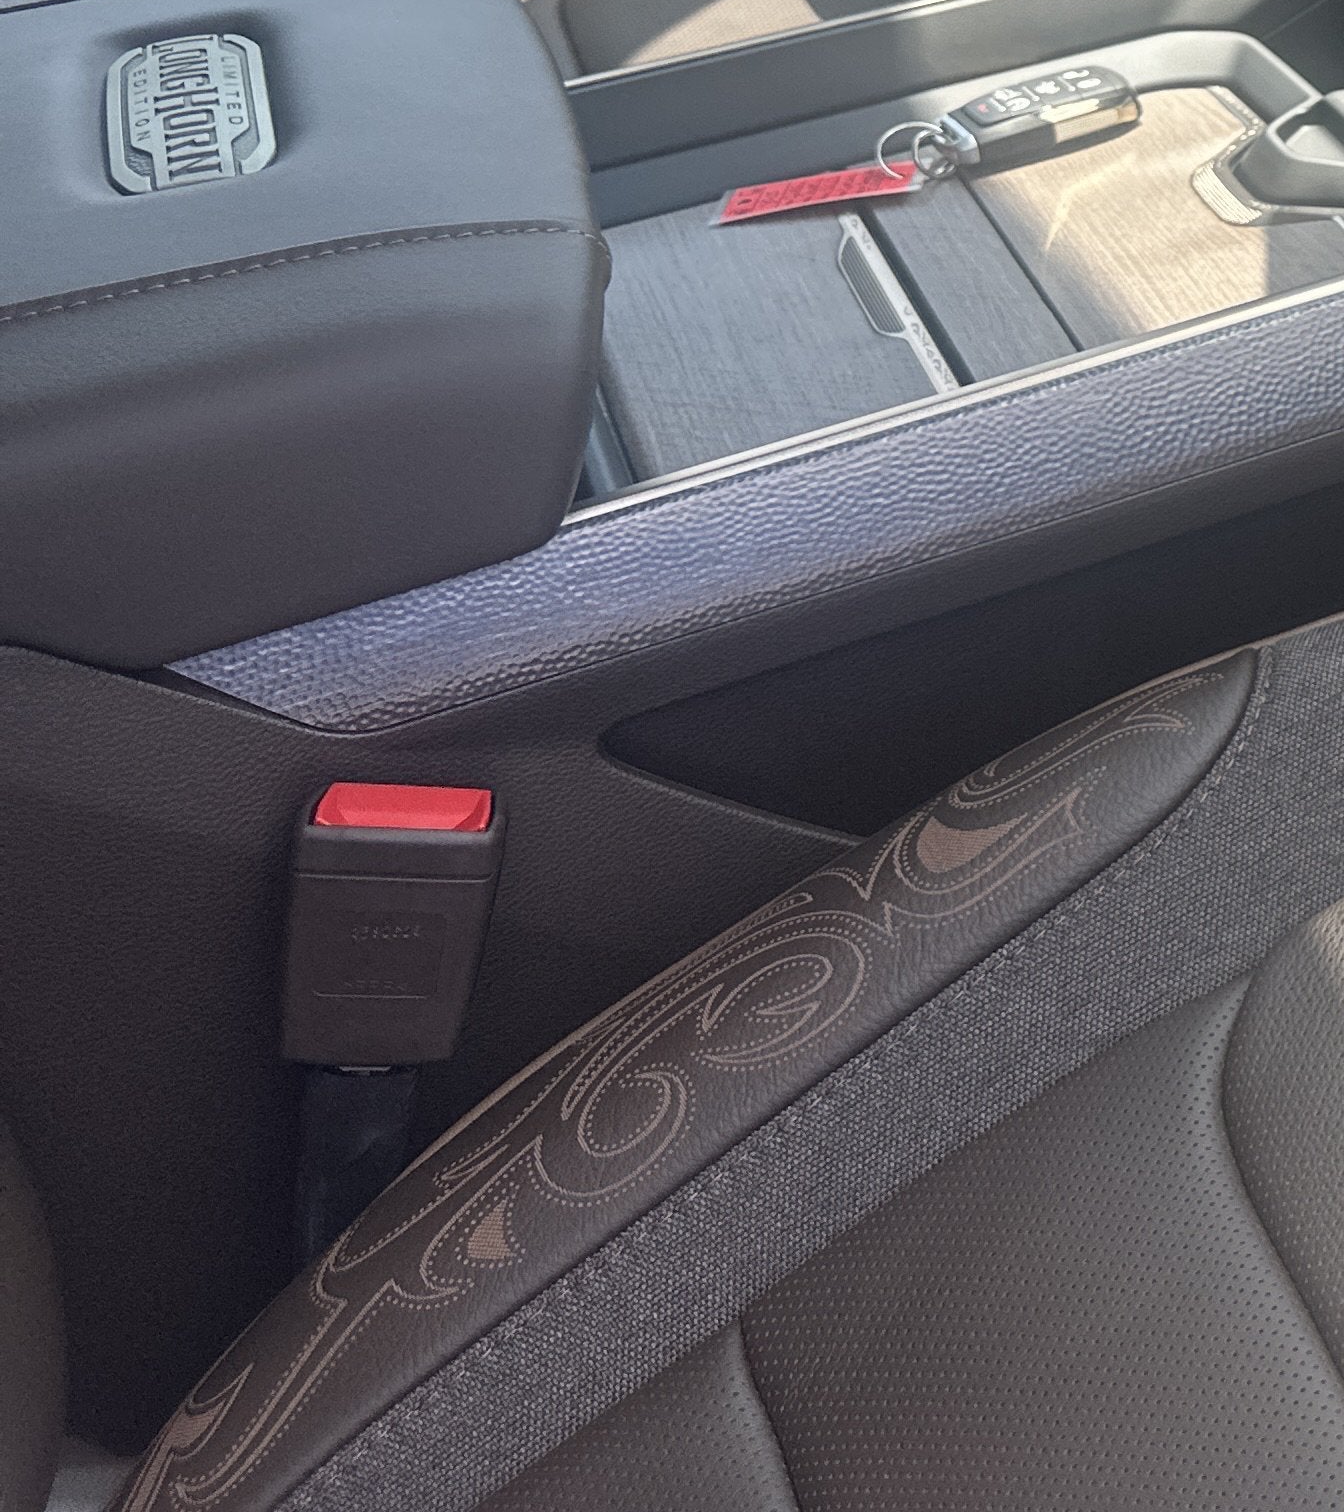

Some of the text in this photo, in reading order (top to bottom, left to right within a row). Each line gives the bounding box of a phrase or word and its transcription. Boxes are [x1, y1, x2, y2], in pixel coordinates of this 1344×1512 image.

[132, 69, 151, 142] EDITION
[151, 36, 223, 182] LONGHORN
[220, 55, 244, 125] LIMITED
